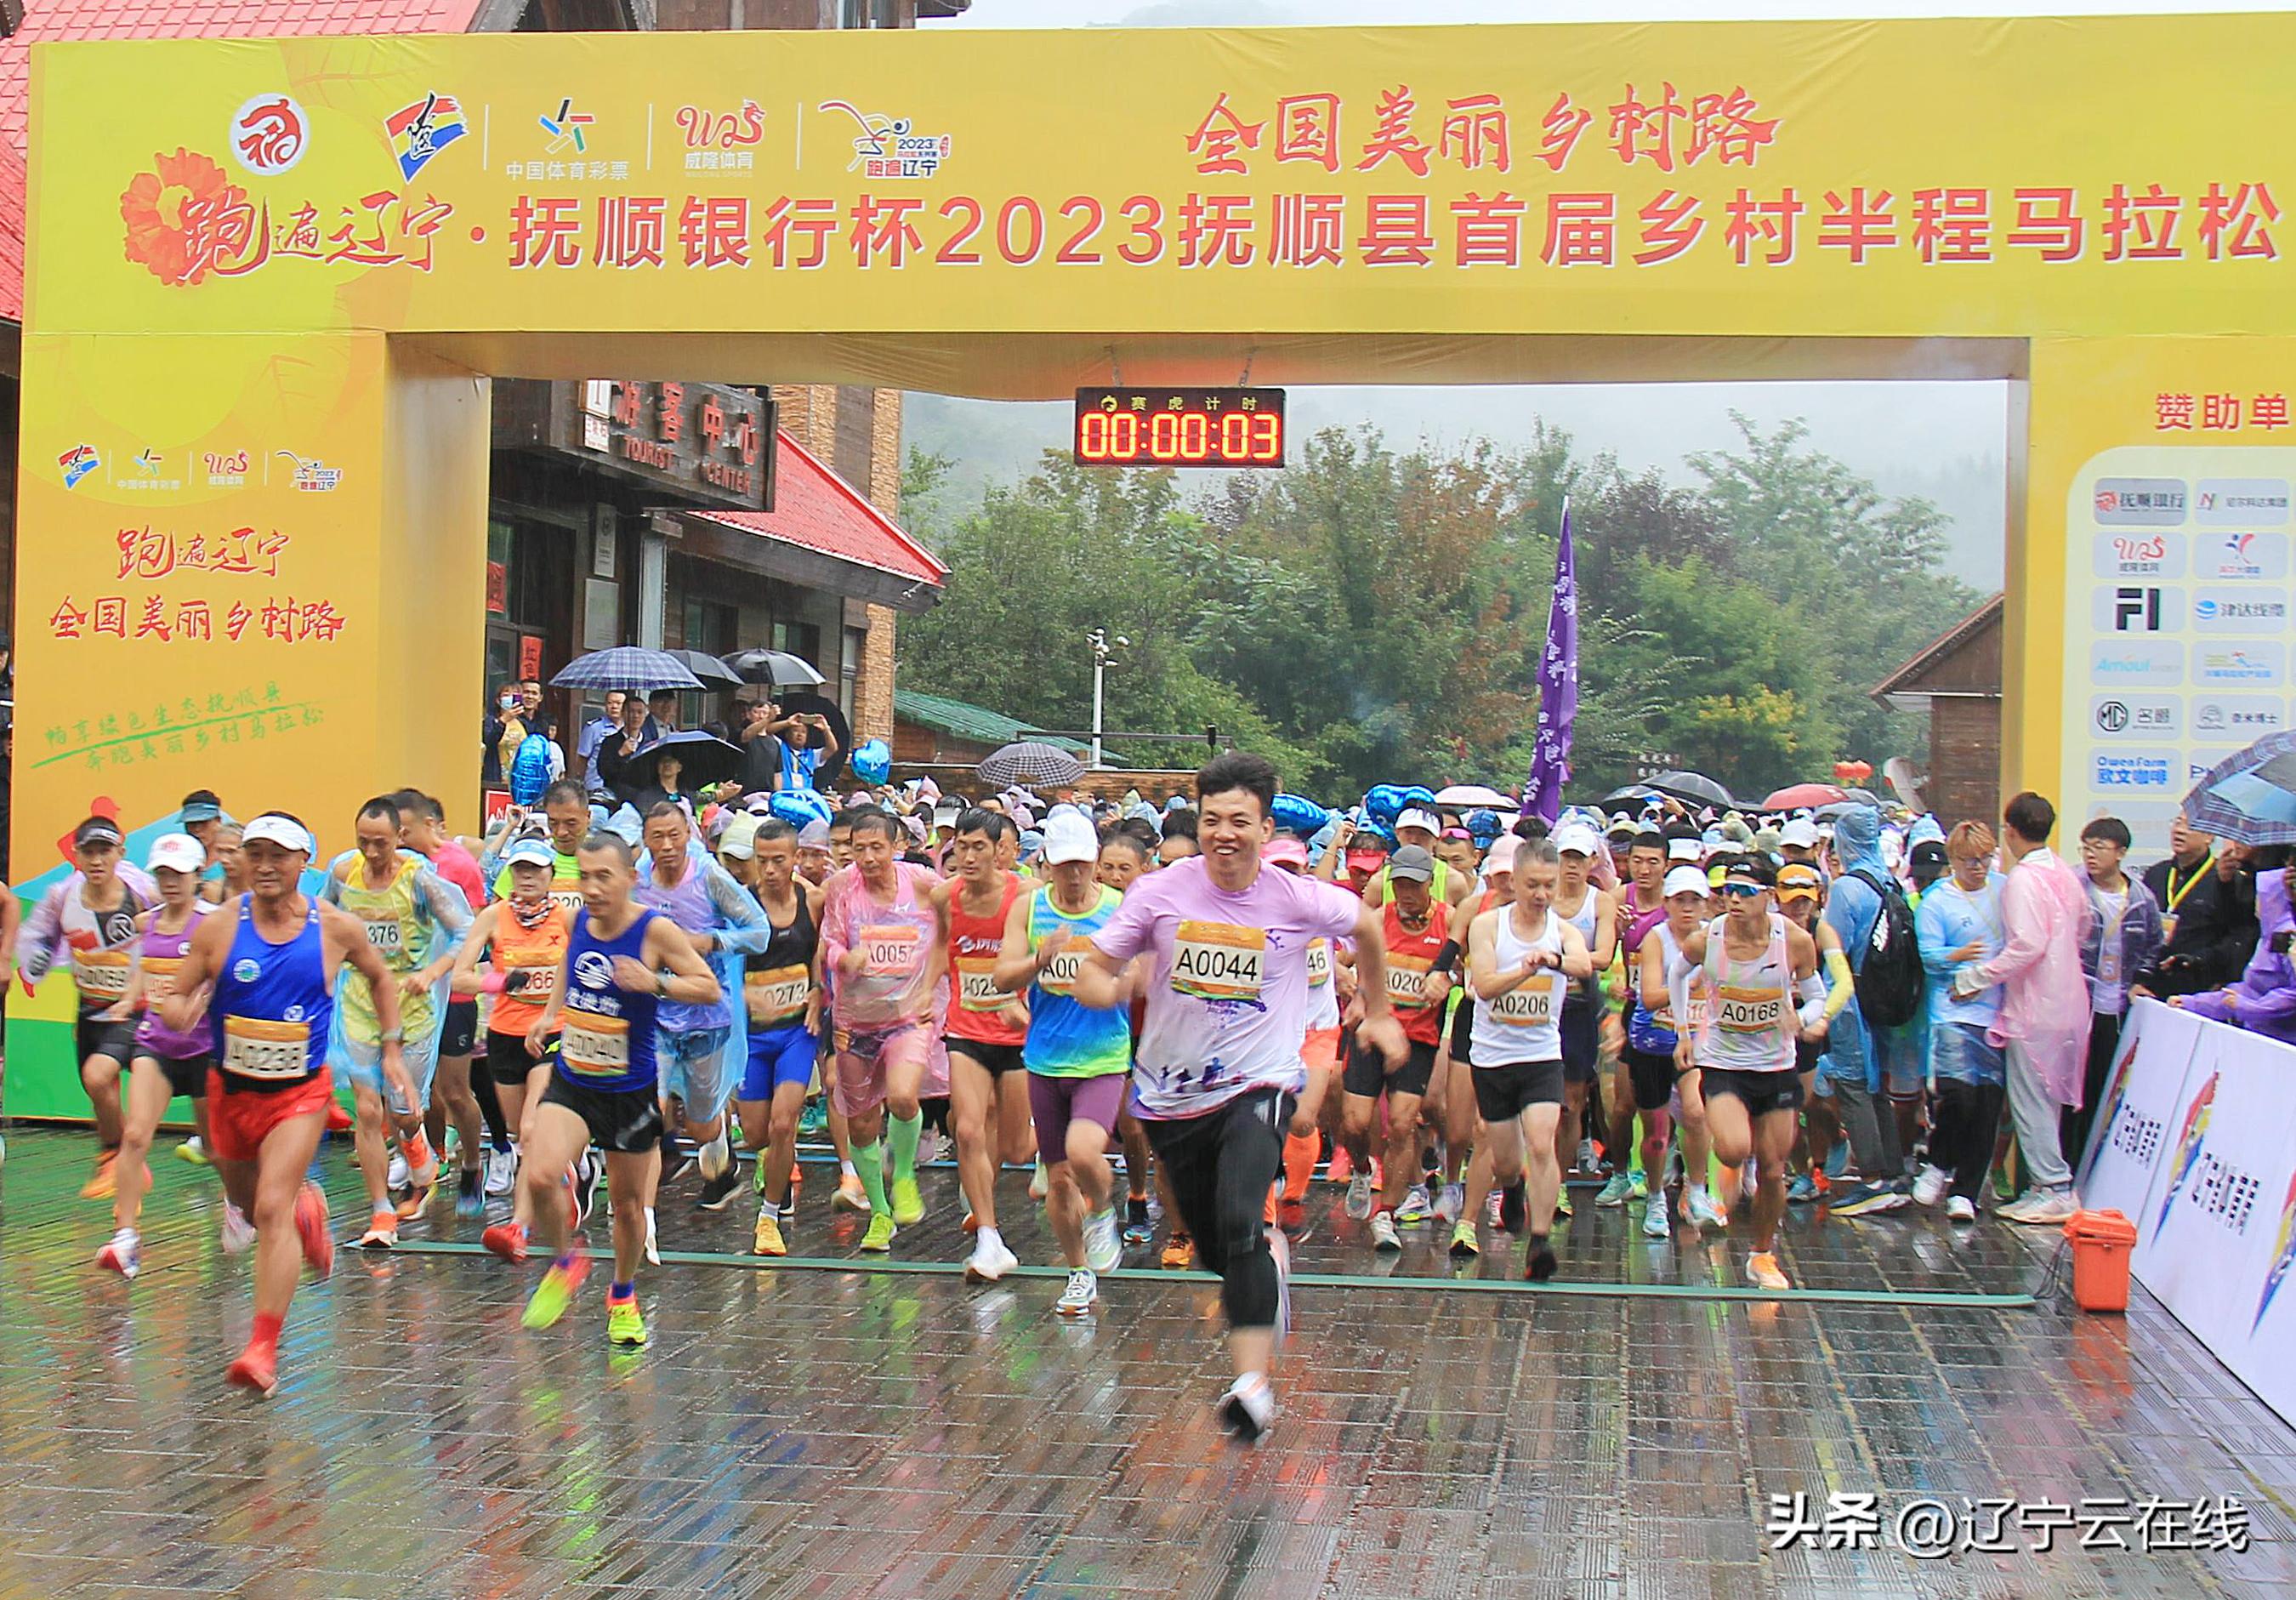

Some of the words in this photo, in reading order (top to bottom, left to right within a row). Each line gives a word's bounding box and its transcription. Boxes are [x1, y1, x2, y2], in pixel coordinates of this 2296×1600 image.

[1184, 81, 1783, 178] 全国美丽乡村路
[506, 160, 629, 180] 中国体育彩票
[1131, 396, 1258, 411] 赛虎计时
[2155, 393, 2290, 430] 赞助单
[1081, 413, 1278, 459] 00:00:03
[624, 435, 673, 470] TOURIST
[708, 462, 752, 497] CENTER
[116, 525, 291, 580] 跑遍辽宁
[48, 593, 349, 644] 全国美丽乡村路
[1175, 947, 1258, 982] A0044
[1492, 995, 1549, 1015] A0206
[1721, 1001, 1780, 1022] A0168
